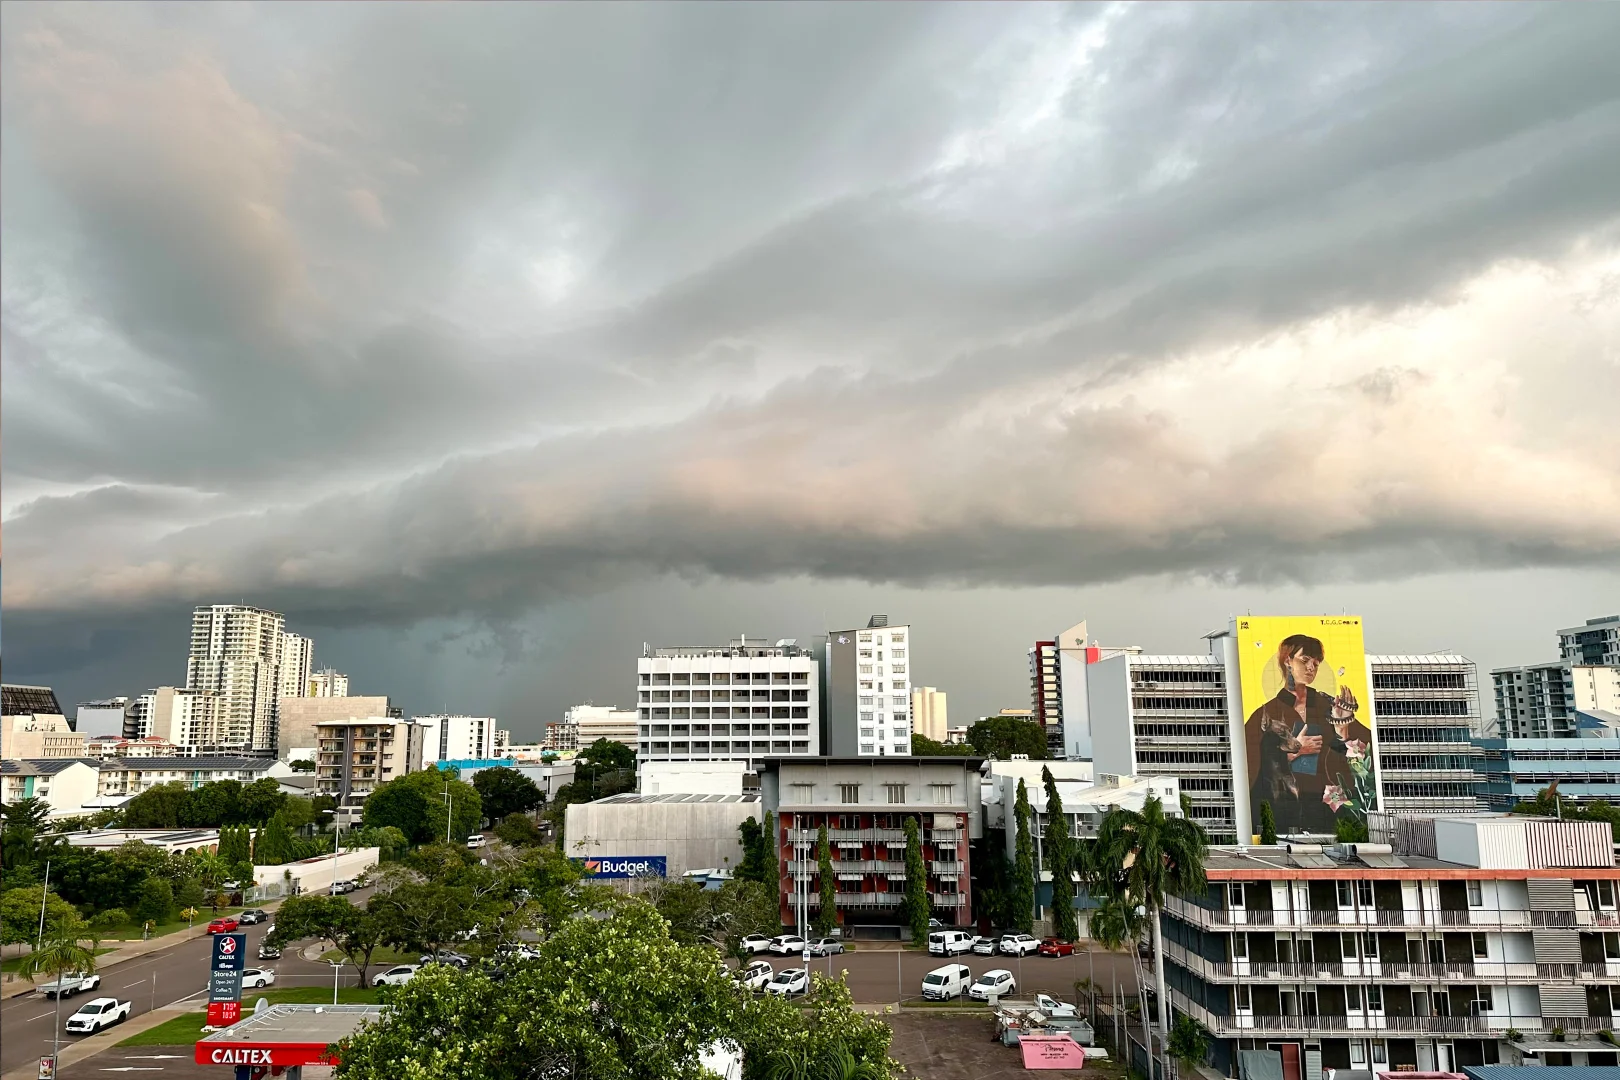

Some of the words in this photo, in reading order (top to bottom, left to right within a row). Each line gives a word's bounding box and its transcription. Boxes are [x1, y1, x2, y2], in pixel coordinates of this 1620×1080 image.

[602, 860, 649, 876] Budget
[842, 926, 852, 938] 12
[211, 1048, 273, 1064] CALTEX
